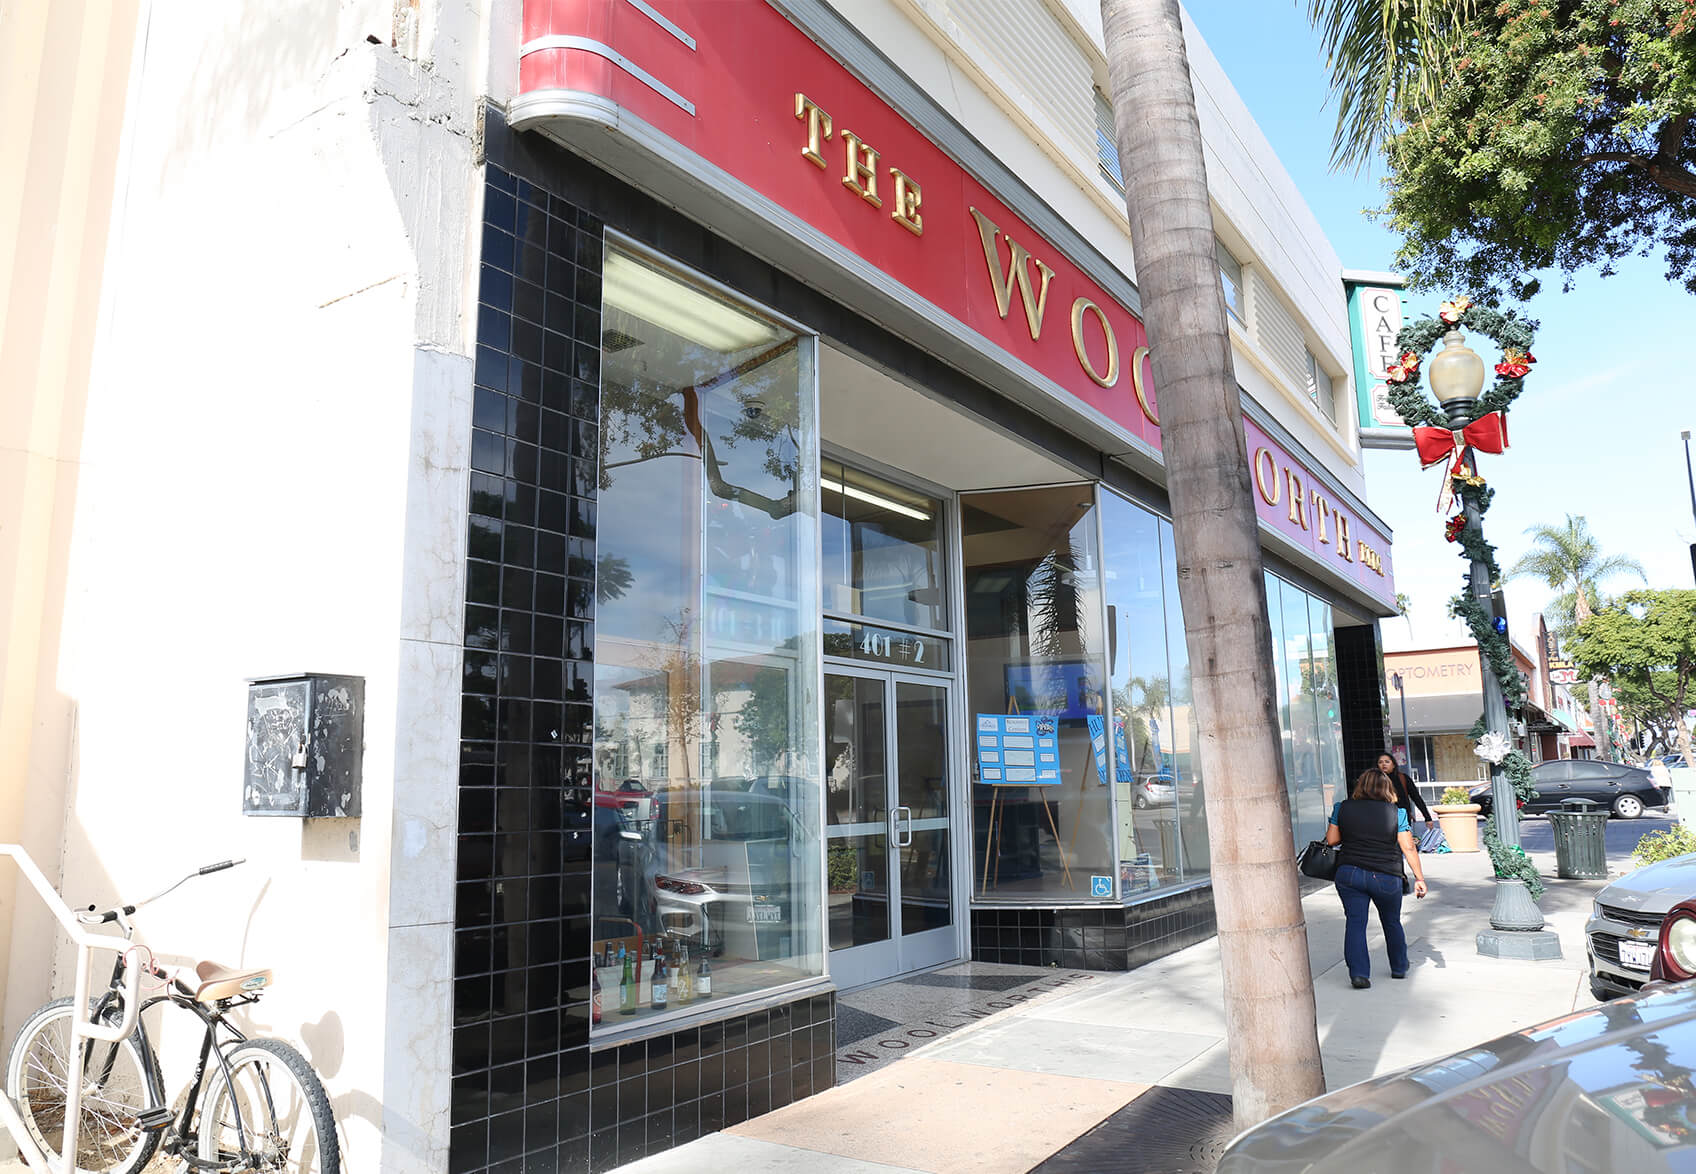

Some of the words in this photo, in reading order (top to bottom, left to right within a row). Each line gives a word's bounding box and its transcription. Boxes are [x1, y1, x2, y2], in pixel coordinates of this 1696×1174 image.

[794, 92, 924, 237] THE
[860, 631, 891, 657] 401
[1386, 663, 1473, 681] OPTOMETRY
